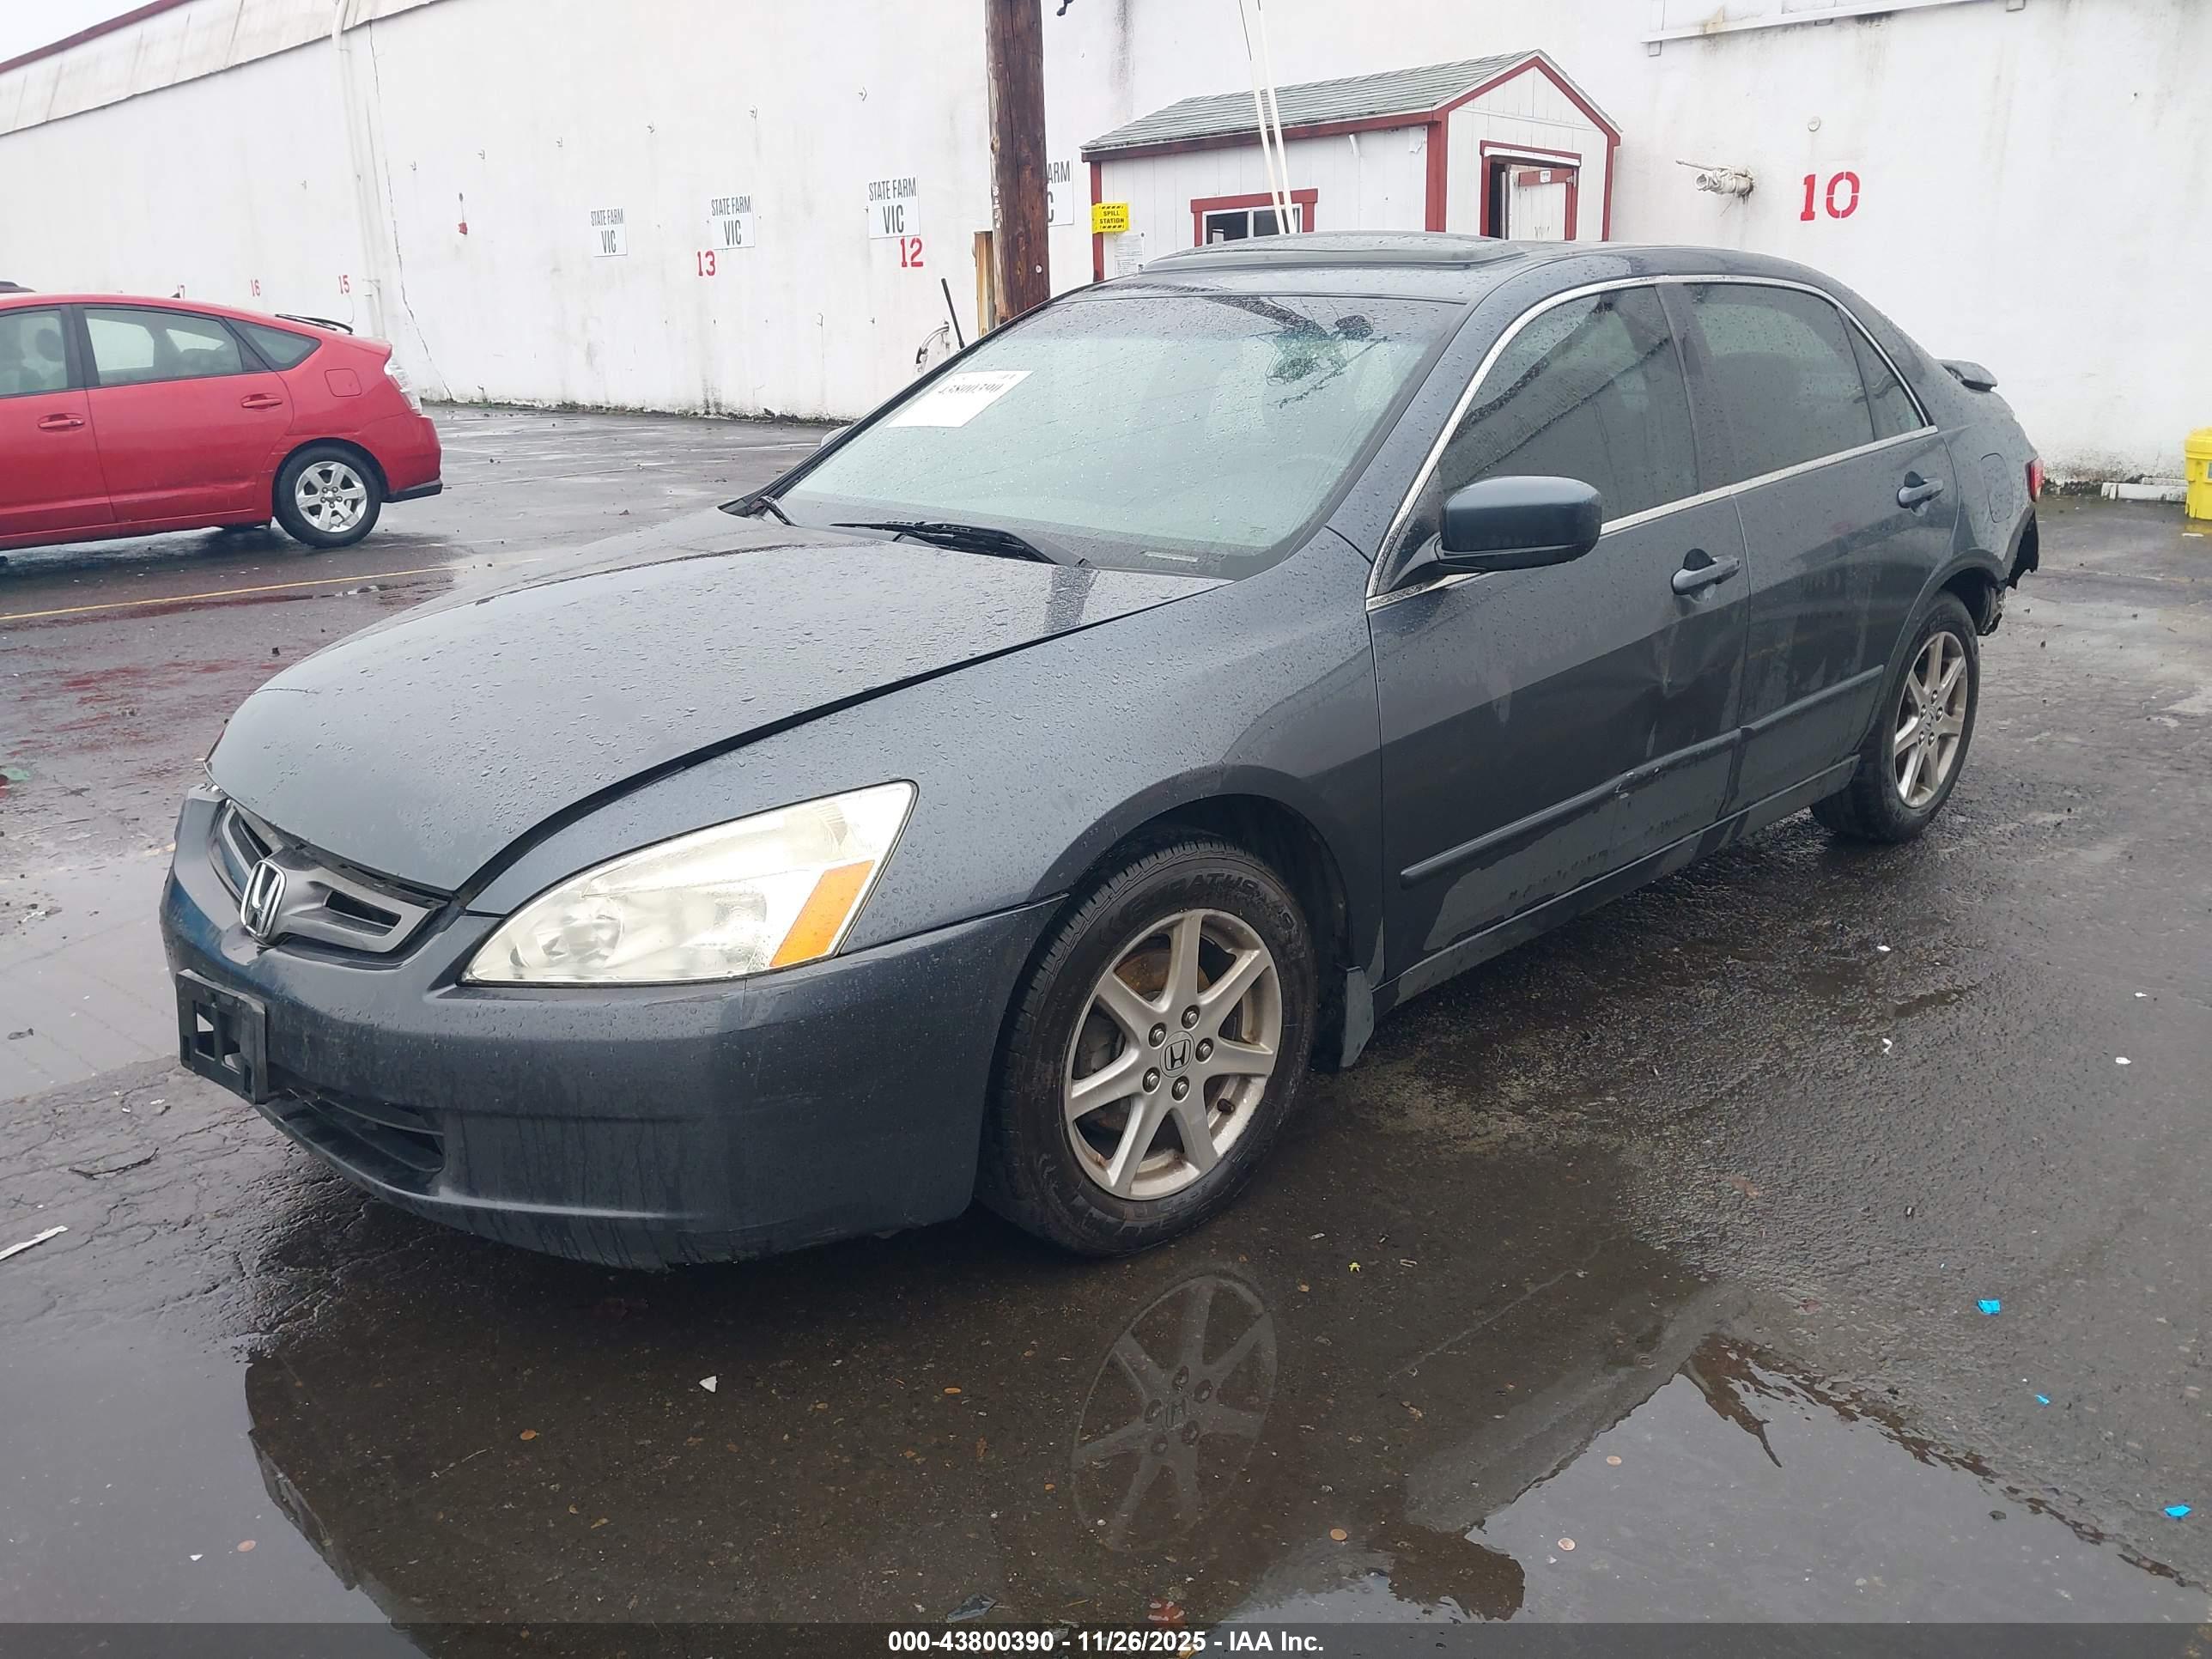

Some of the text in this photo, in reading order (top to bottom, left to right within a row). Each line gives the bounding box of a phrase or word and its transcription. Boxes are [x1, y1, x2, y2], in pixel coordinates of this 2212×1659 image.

[1047, 160, 1071, 184] ARM
[868, 176, 917, 201] STATE FARM
[1799, 170, 1861, 222] 10
[590, 208, 624, 227] STATE FARM
[711, 195, 751, 216] STATE FARM
[882, 204, 905, 234] VIC
[600, 229, 617, 254] VIC
[723, 219, 742, 246] VIC
[696, 250, 716, 276] 13
[900, 237, 924, 268] 12
[337, 274, 350, 295] 15
